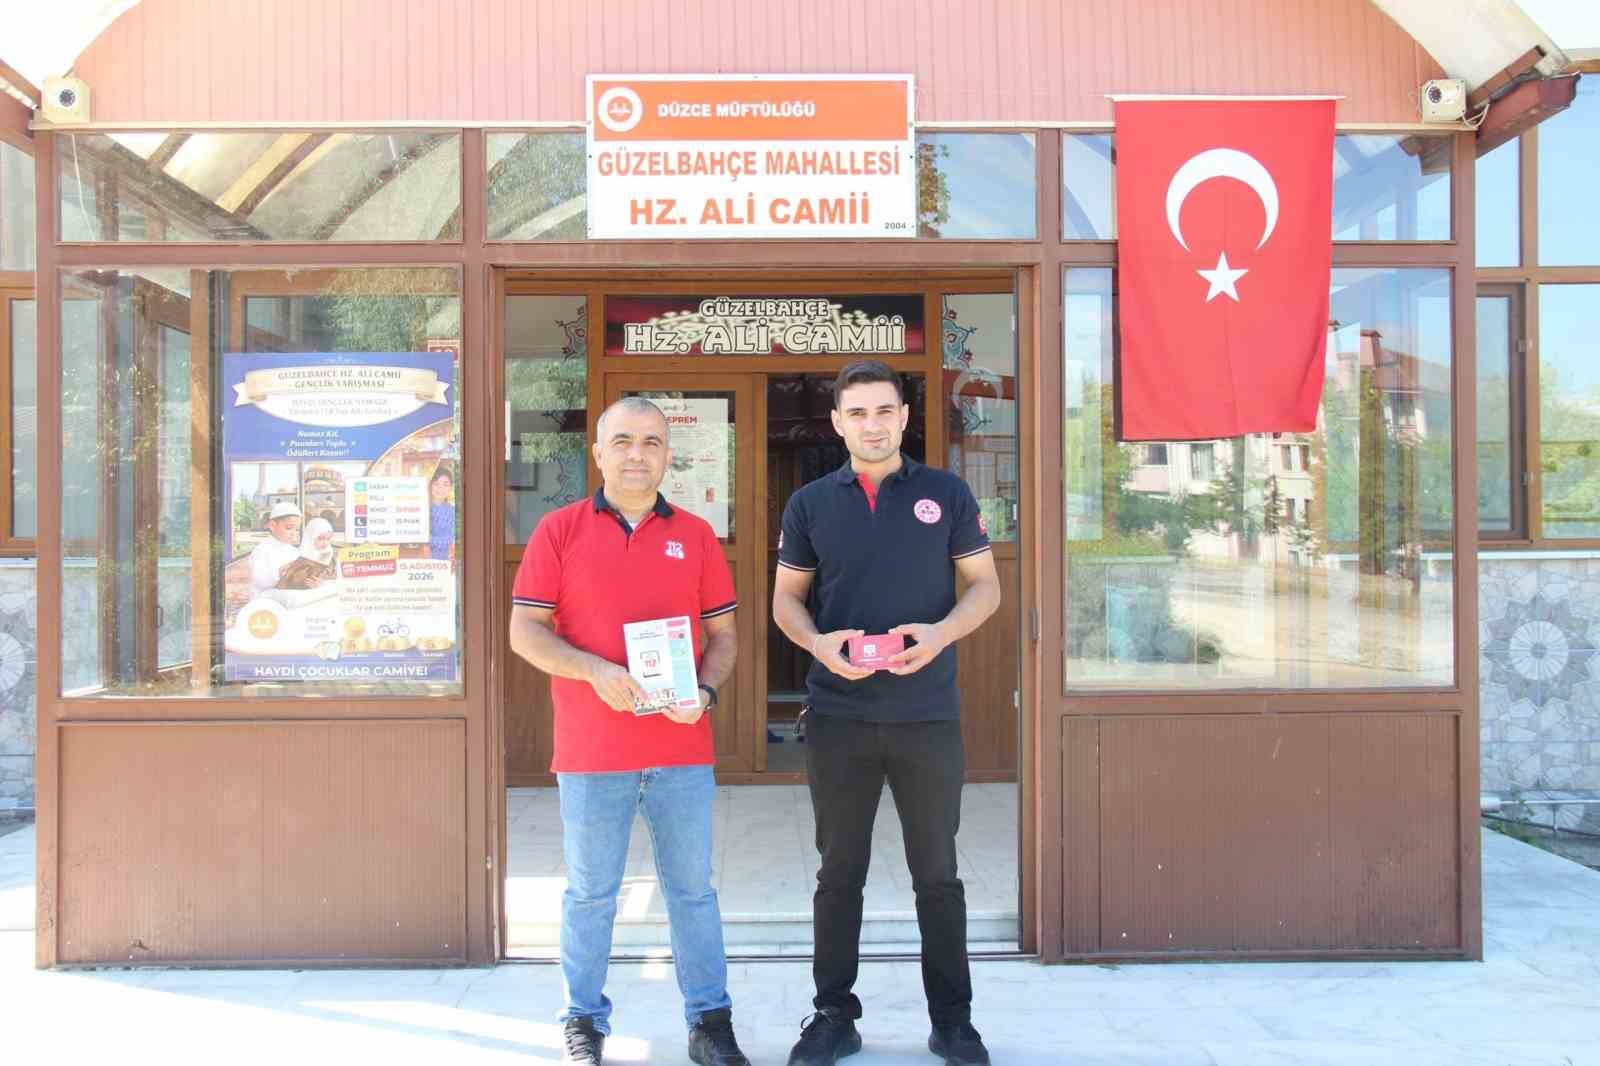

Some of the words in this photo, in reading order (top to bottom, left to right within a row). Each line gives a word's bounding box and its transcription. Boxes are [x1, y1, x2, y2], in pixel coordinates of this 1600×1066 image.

[657, 101, 711, 117] DÜZCE
[716, 101, 816, 117] MÜFTÜLÜĞÜ
[598, 147, 757, 181] GÜZELBAHÇE
[765, 145, 900, 175] MAHALLESİ
[630, 199, 687, 225] HZ.
[699, 192, 755, 225] ALİ
[769, 191, 870, 225] CAMİİ
[700, 298, 829, 320] GÜZELBAHÇE
[703, 317, 770, 353] ALİ
[784, 316, 905, 353] CAMİİ
[666, 415, 698, 424] EPREM
[667, 541, 683, 551] 112
[348, 550, 391, 560] Program
[407, 572, 434, 581] 2026
[255, 664, 295, 676] HAYDİ
[298, 665, 370, 679] ÇOCUKLAR
[373, 664, 428, 676] CAMİYE!
